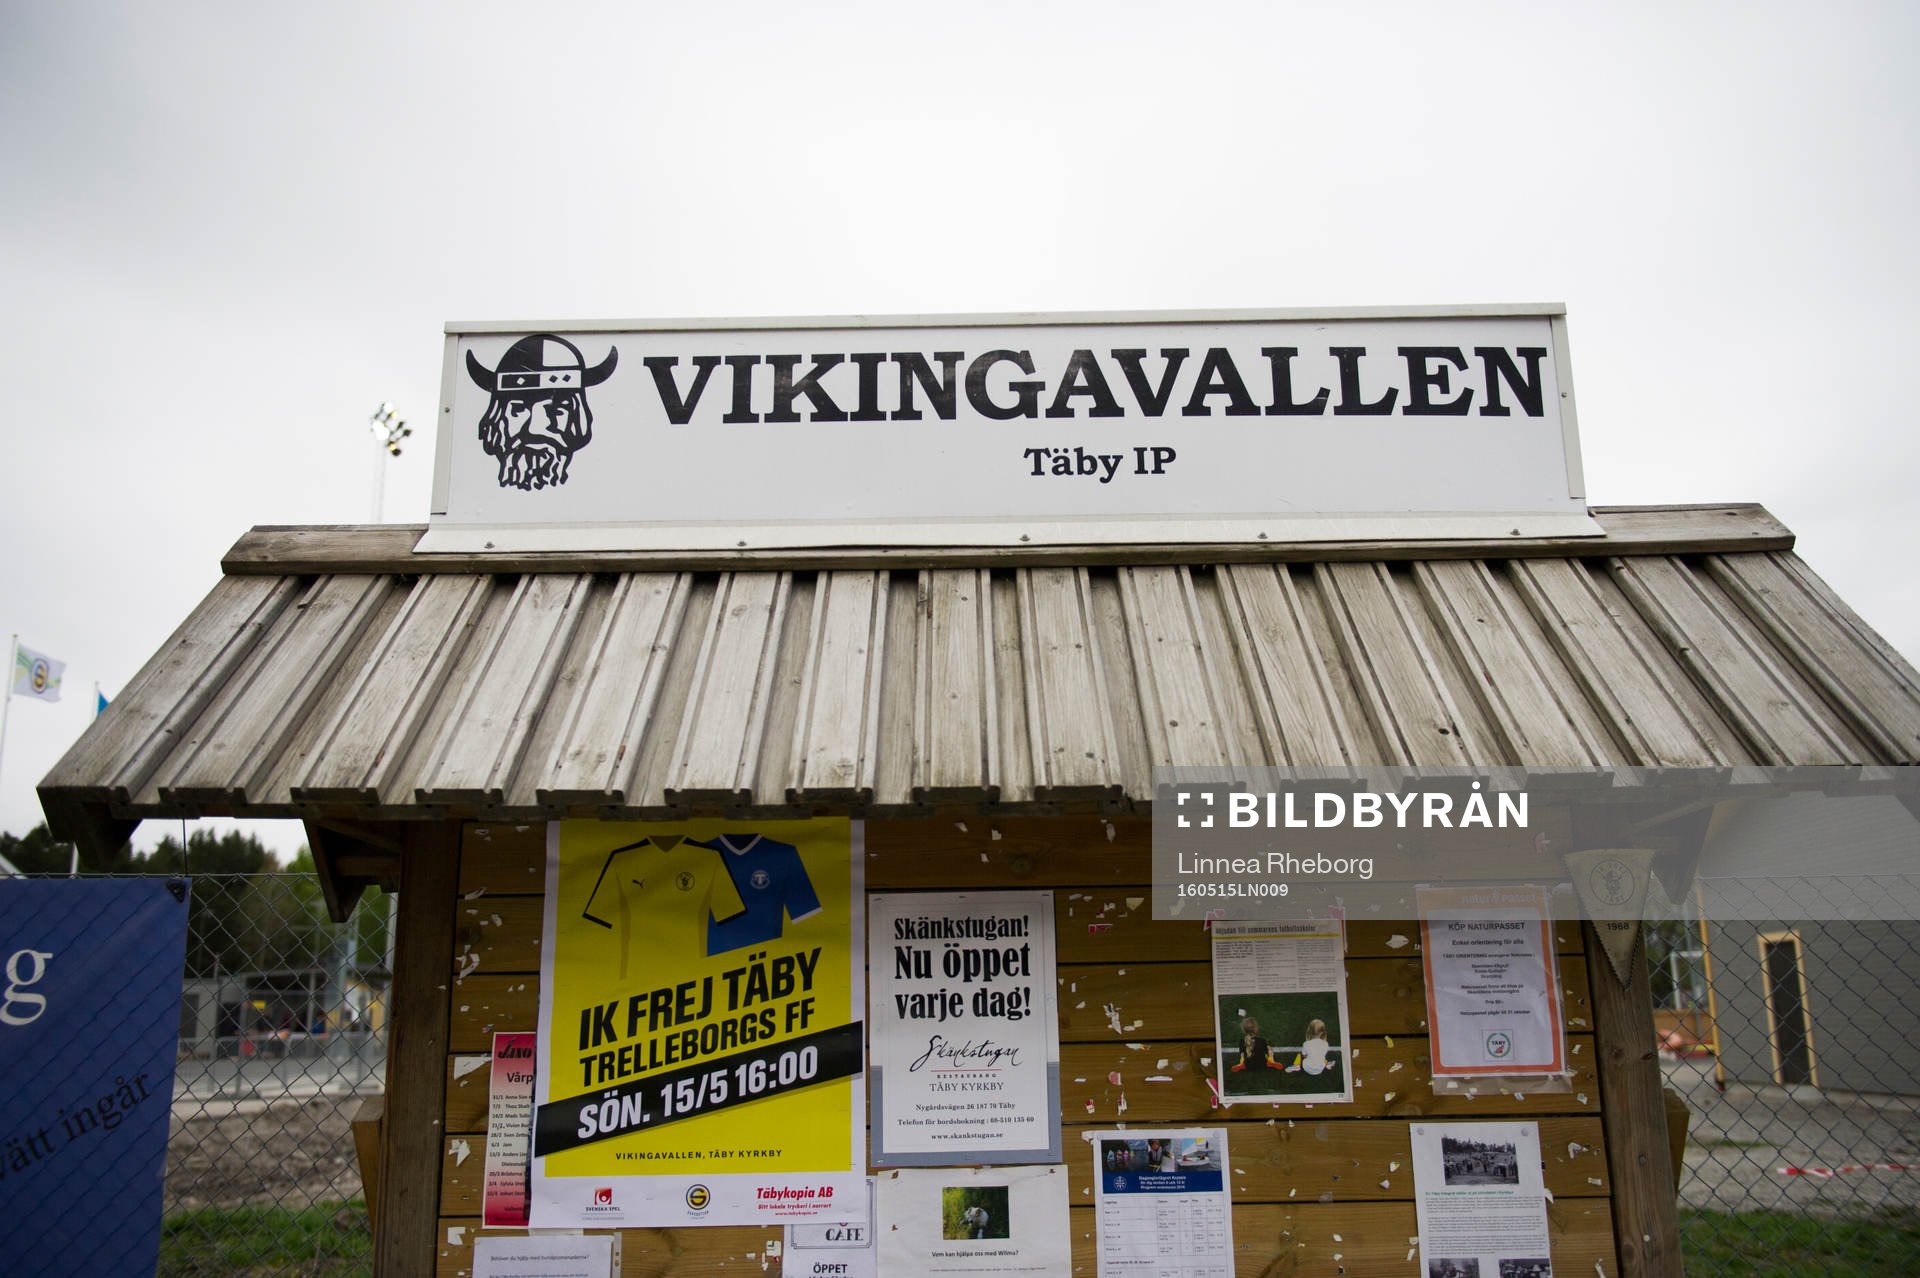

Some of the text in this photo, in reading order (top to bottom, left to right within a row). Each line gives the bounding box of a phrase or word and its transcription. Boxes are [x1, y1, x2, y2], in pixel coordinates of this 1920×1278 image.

[643, 346, 1547, 425] VIKINGAVALLEN
[1023, 446, 1177, 484] Täby IP
[894, 914, 1029, 941] Skänkstugan!
[1448, 922, 1526, 931] KÖP NATURPASSET
[894, 942, 1031, 982] Nu öppet
[578, 946, 823, 1051] IK FREJ TÄBY
[895, 986, 1031, 1023] varje dag!
[579, 997, 816, 1088] TRELLEBORGS FF
[909, 1034, 1024, 1073] Skänkstugan
[576, 1045, 819, 1139] SÖN. 15/5 16:00
[929, 1081, 1005, 1093] TÄBY KYRKBY
[57, 1074, 149, 1141] ingår
[915, 1103, 966, 1113] Nygårdsvägen
[998, 1102, 1016, 1111] Täby
[897, 1119, 924, 1127] Telefon
[925, 1118, 936, 1126] för
[931, 1131, 1004, 1141] www.skankstugan.se
[615, 1149, 783, 1161] VIKINGAVALLEN, TÄBY KYRKBY
[756, 1186, 834, 1201] Täbykopia AB
[812, 1261, 848, 1274] ÖPPET
[931, 1250, 945, 1258] Vem
[945, 1250, 956, 1258] kan
[956, 1250, 974, 1259] hjälpa
[984, 1249, 997, 1257] med
